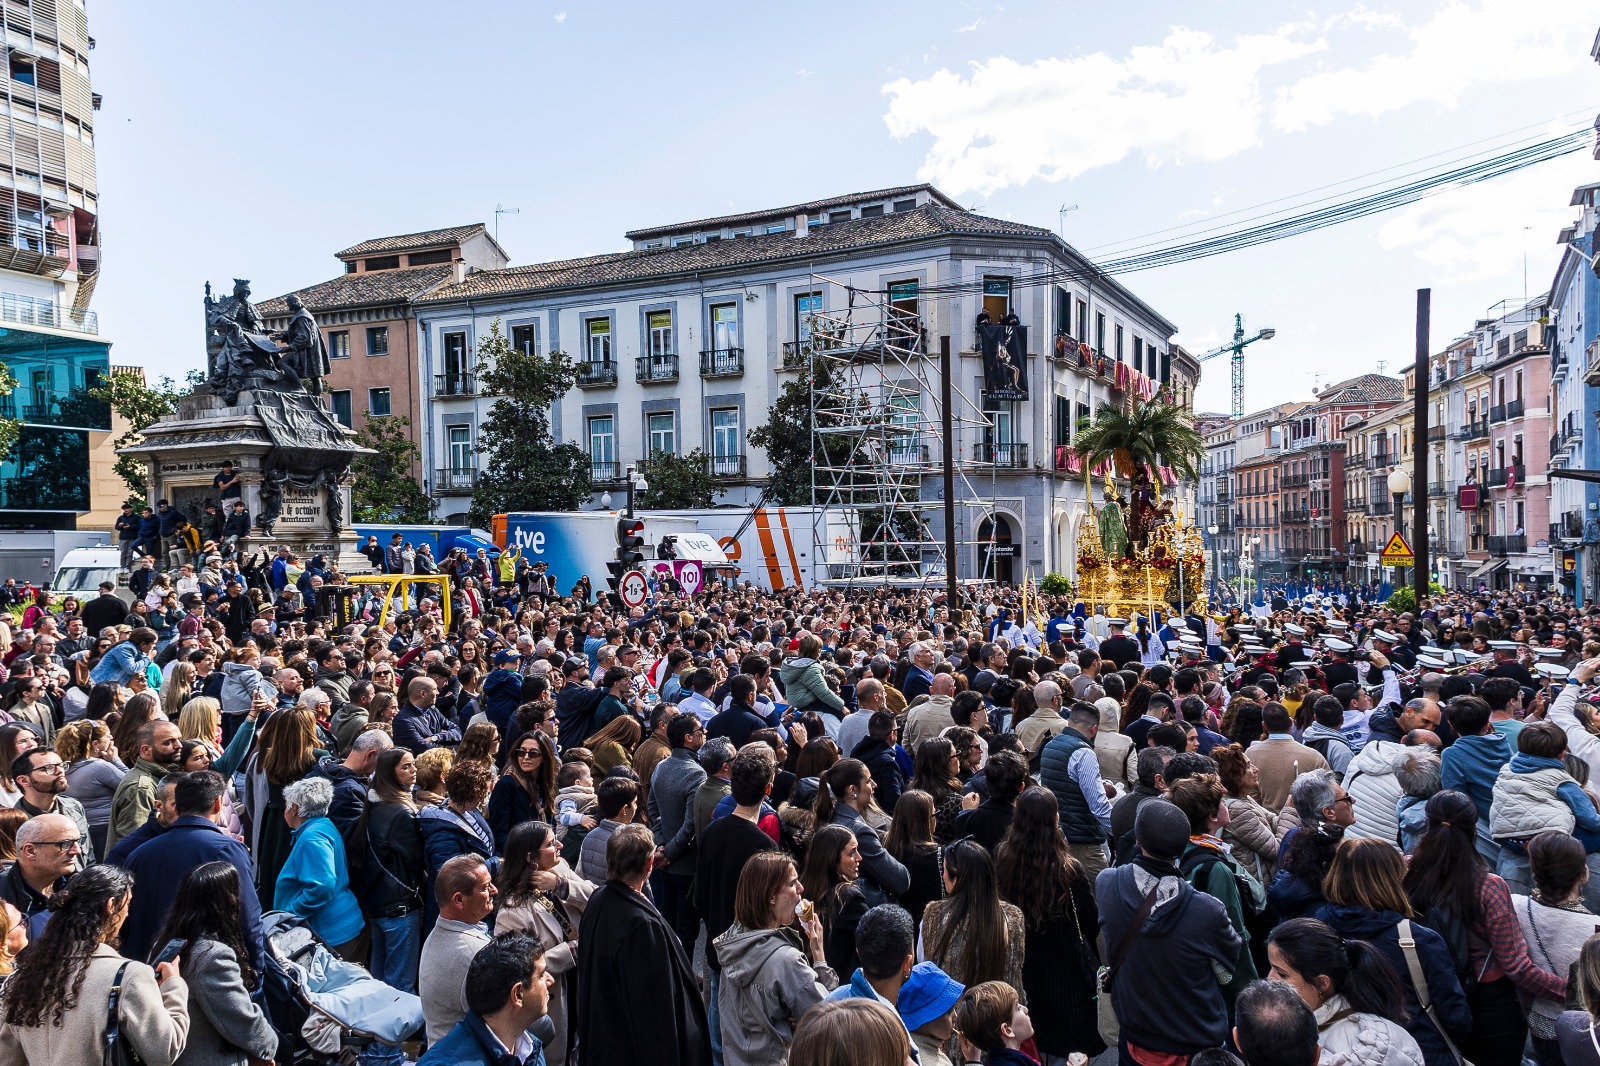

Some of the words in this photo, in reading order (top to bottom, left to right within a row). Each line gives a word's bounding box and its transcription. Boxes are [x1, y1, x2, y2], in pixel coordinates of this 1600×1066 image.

[514, 526, 545, 554] tve
[684, 538, 712, 552] tve
[682, 571, 697, 583] 101
